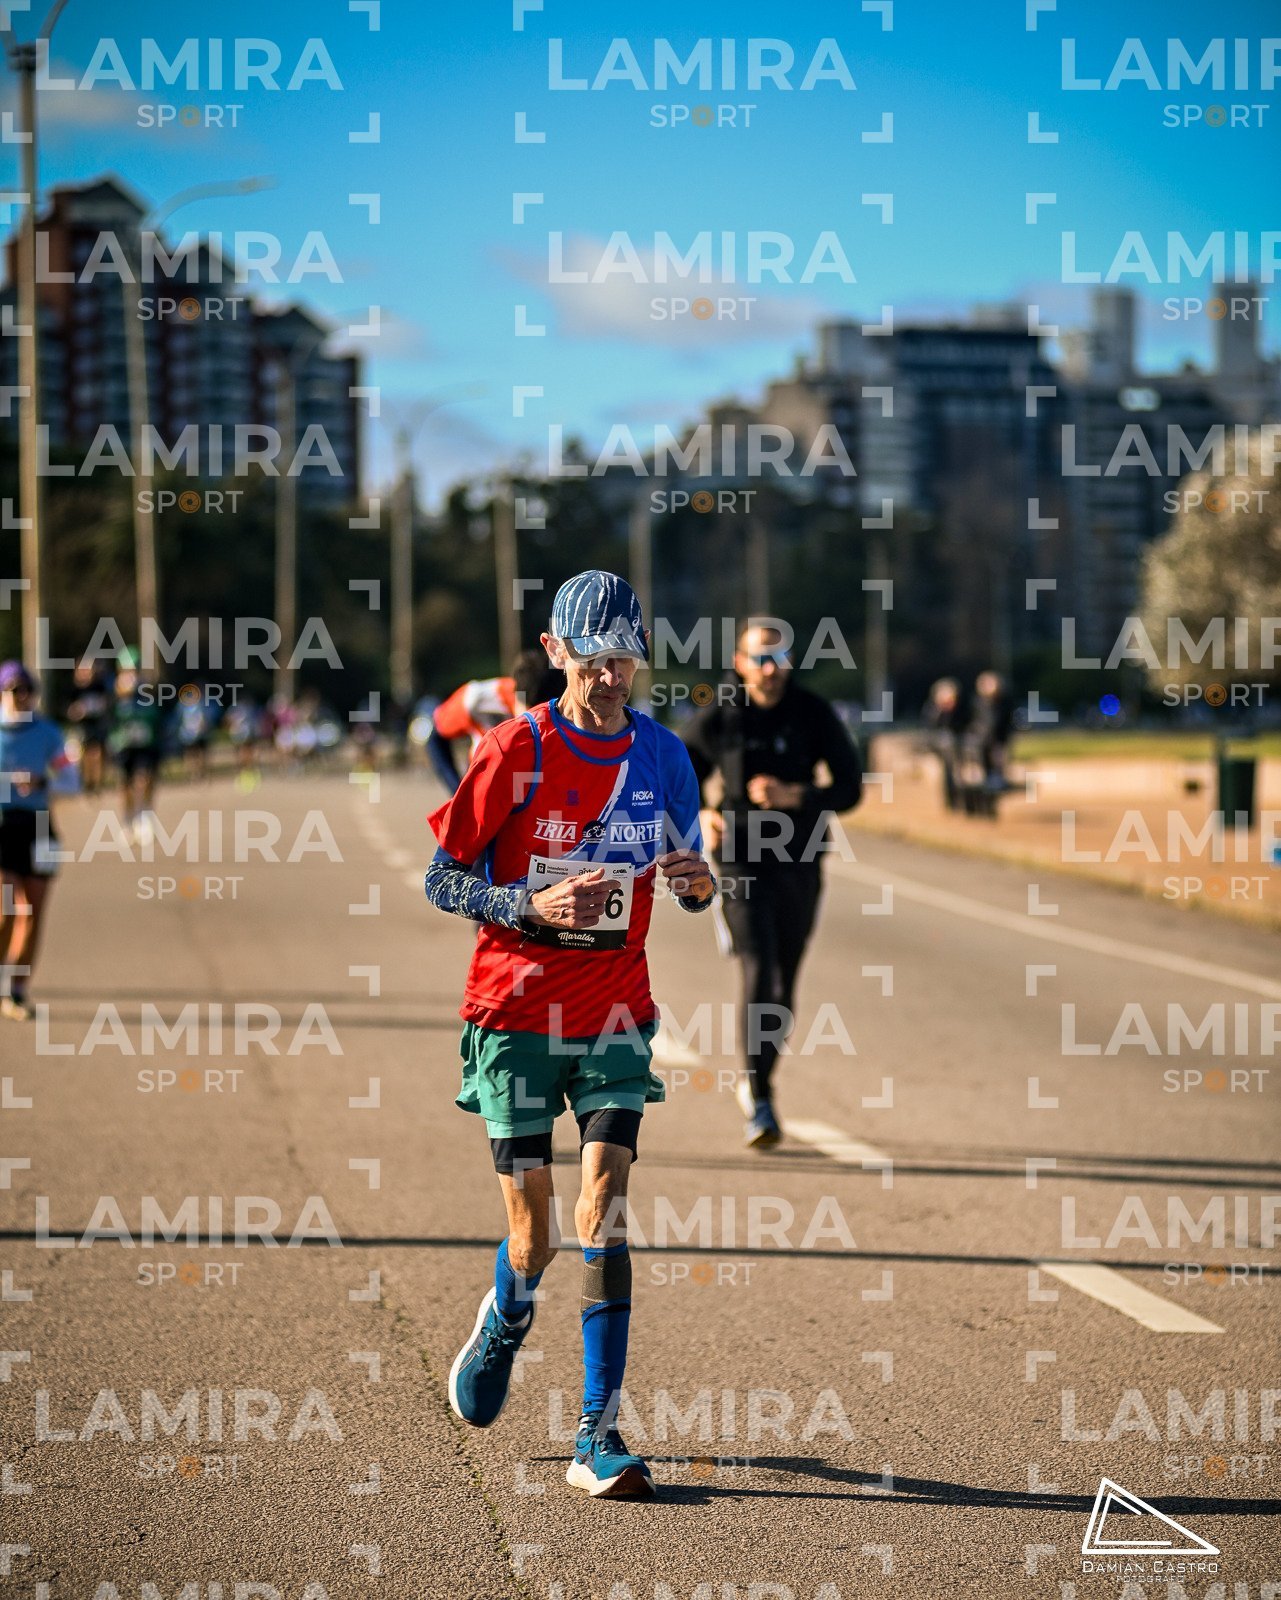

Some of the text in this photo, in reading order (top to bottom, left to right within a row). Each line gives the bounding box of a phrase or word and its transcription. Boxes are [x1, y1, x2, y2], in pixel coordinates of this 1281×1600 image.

[632, 790, 654, 801] HOKA
[534, 820, 662, 841] TRIA NORTE
